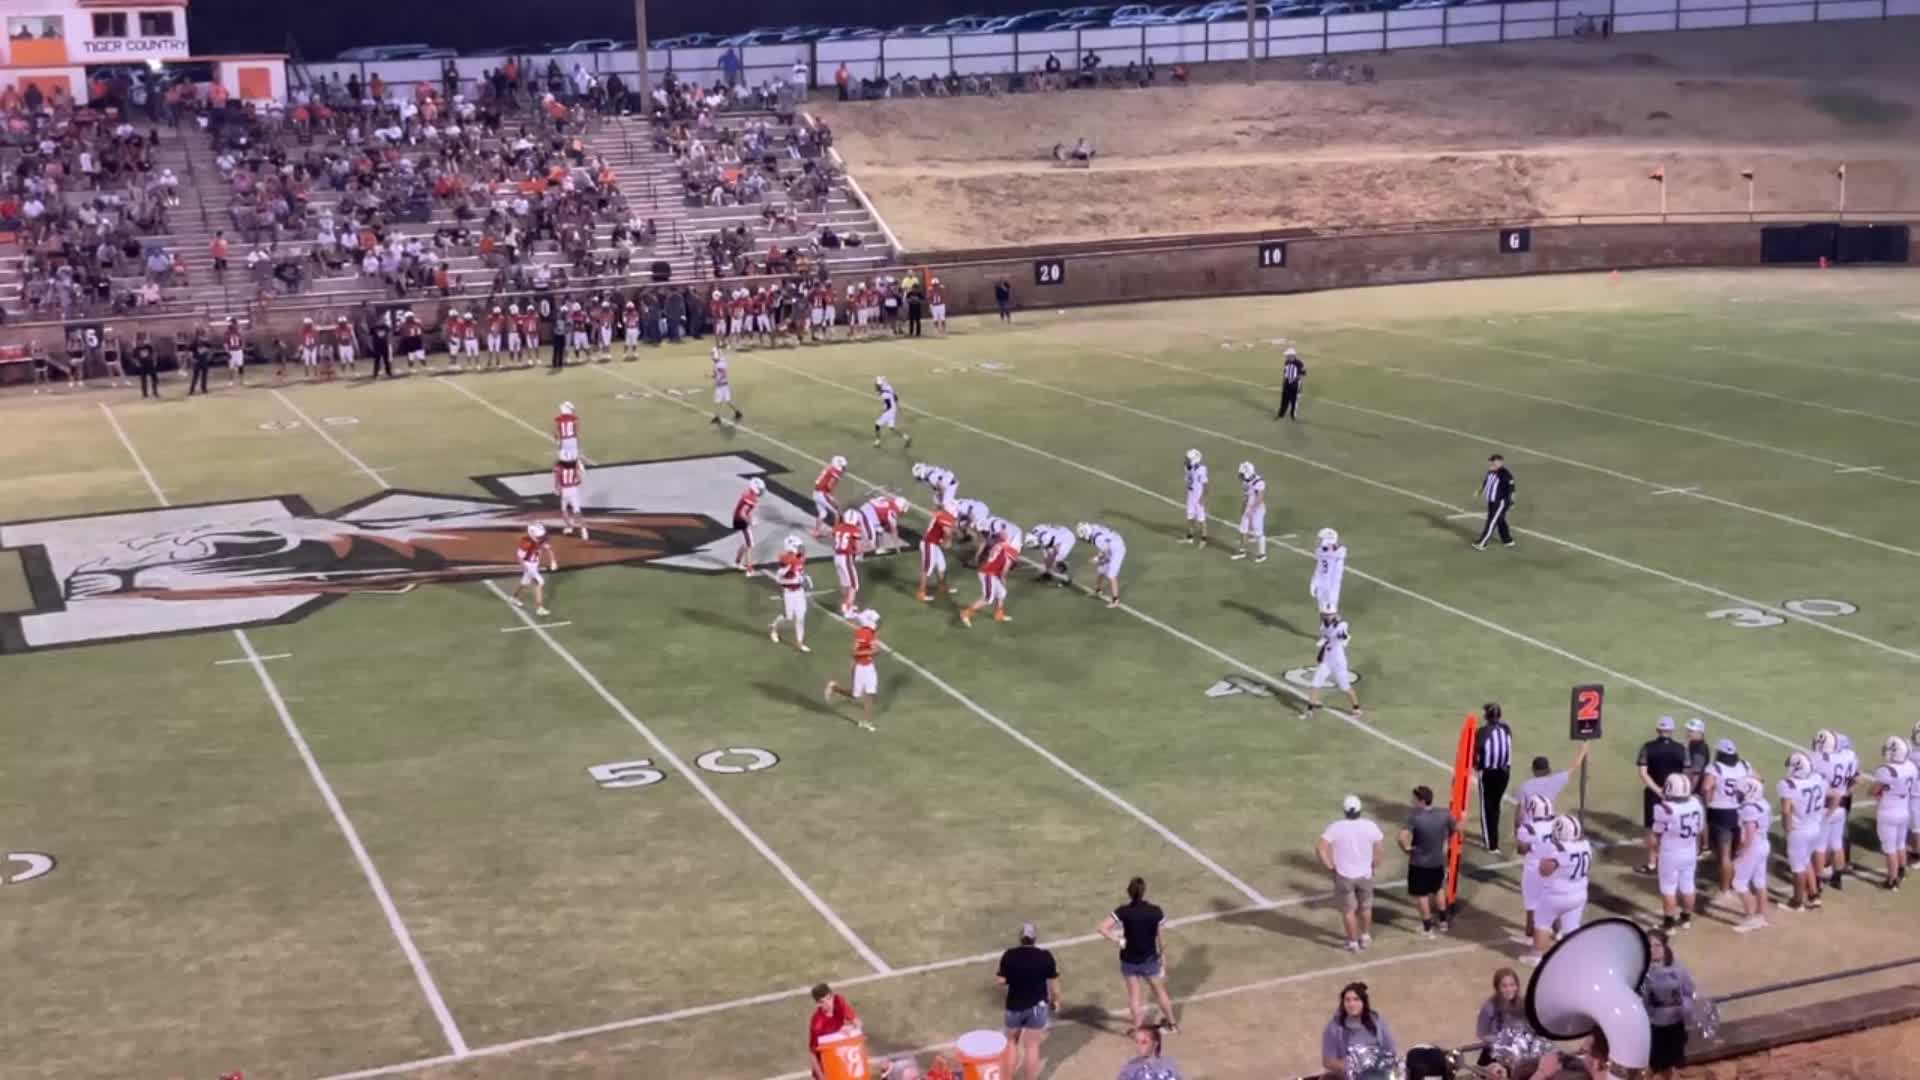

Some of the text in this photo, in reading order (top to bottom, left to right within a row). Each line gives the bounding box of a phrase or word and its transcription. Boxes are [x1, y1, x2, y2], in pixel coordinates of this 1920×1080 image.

[83, 39, 186, 53] TIGER COUNTRY
[1264, 248, 1281, 265] 10
[1040, 264, 1060, 281] 20
[1706, 599, 1858, 628] 30
[1577, 690, 1600, 720] 2
[588, 748, 778, 788] 50
[1802, 785, 1824, 814] 72
[1570, 851, 1590, 880] 70
